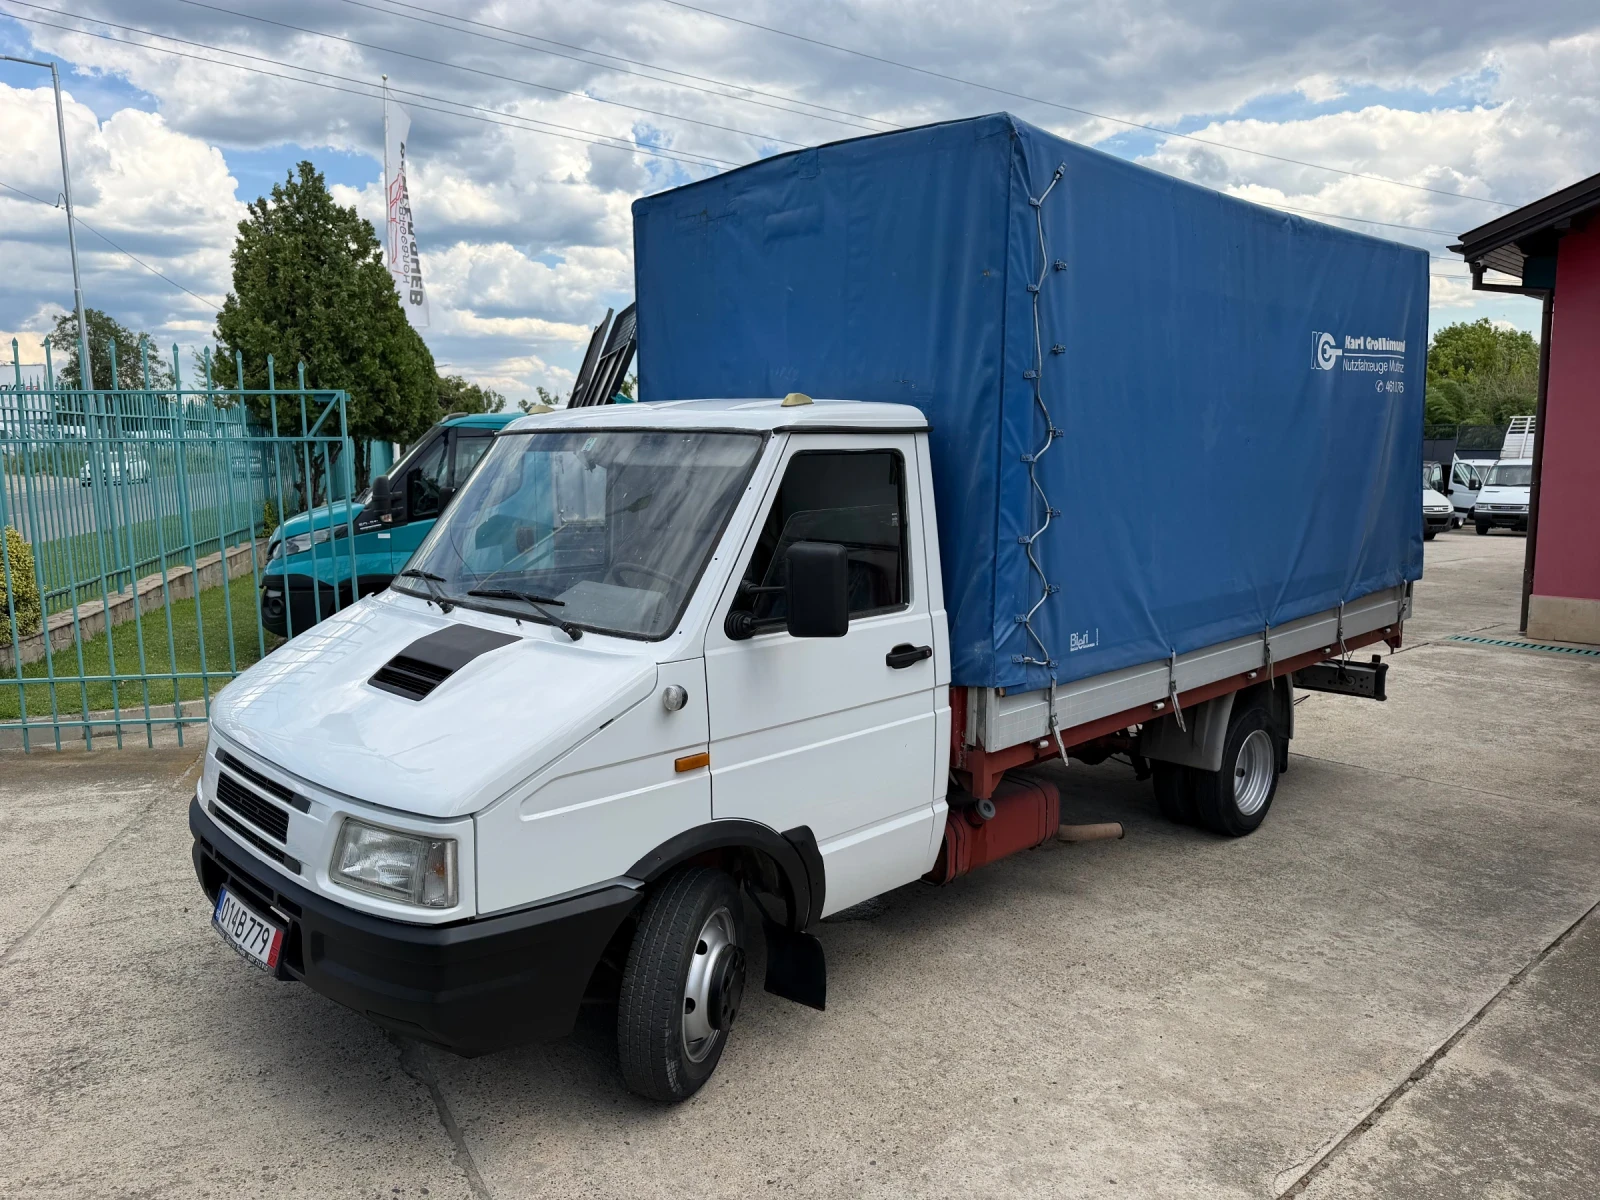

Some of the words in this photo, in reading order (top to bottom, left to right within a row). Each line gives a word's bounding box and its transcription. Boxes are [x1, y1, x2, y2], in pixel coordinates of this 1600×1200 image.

[1345, 335, 1364, 350] Karl
[1070, 631, 1089, 650] Bieri
[221, 897, 270, 955] 014B779
